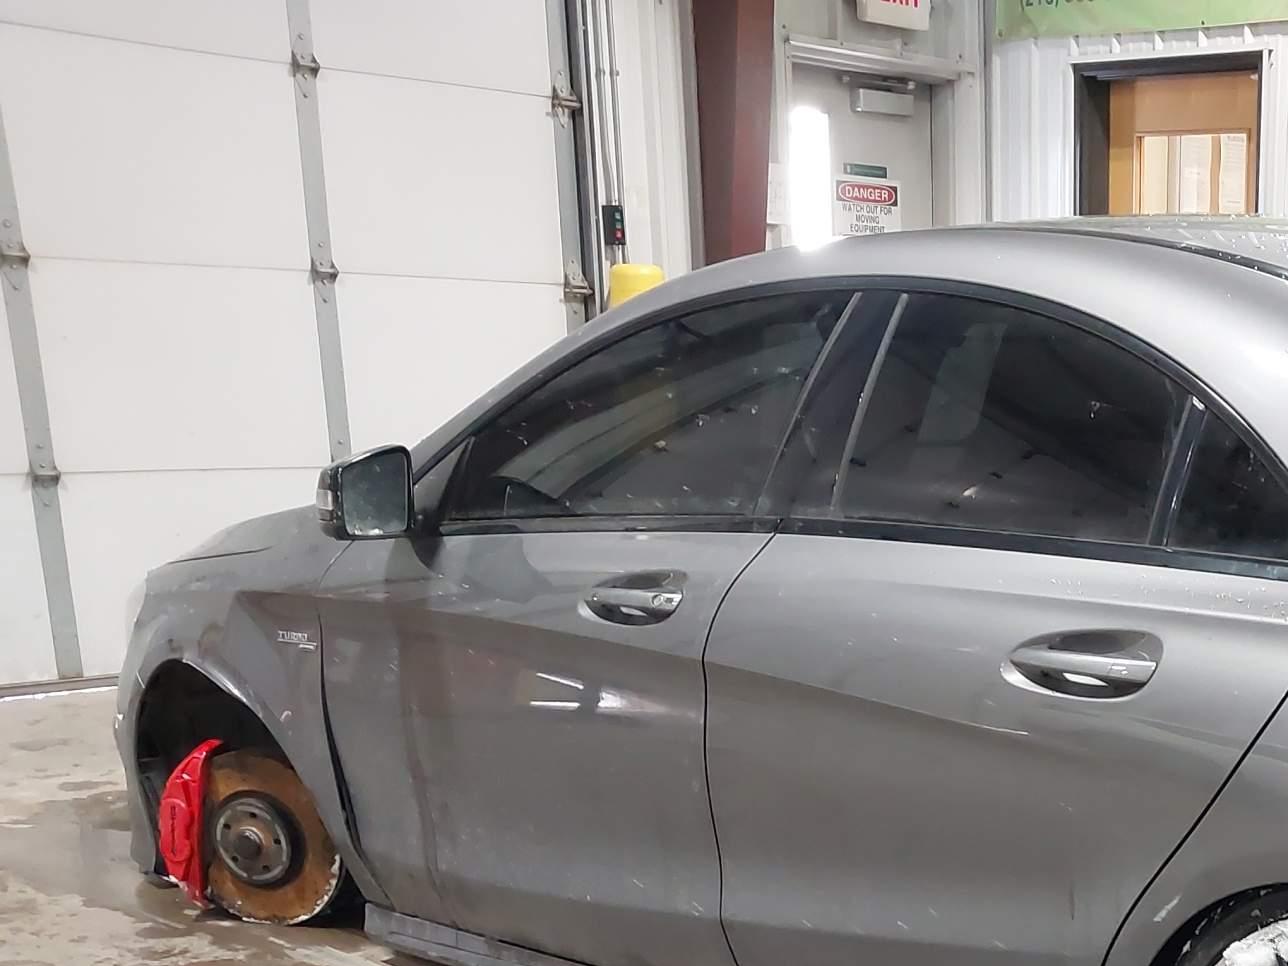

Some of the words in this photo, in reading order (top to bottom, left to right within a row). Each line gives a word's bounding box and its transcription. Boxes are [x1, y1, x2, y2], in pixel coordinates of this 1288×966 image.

[845, 186, 889, 201] DANGER
[842, 202, 865, 213] WATCH
[866, 204, 879, 214] OUT
[880, 206, 893, 216] FOR
[855, 214, 880, 225] MOVING
